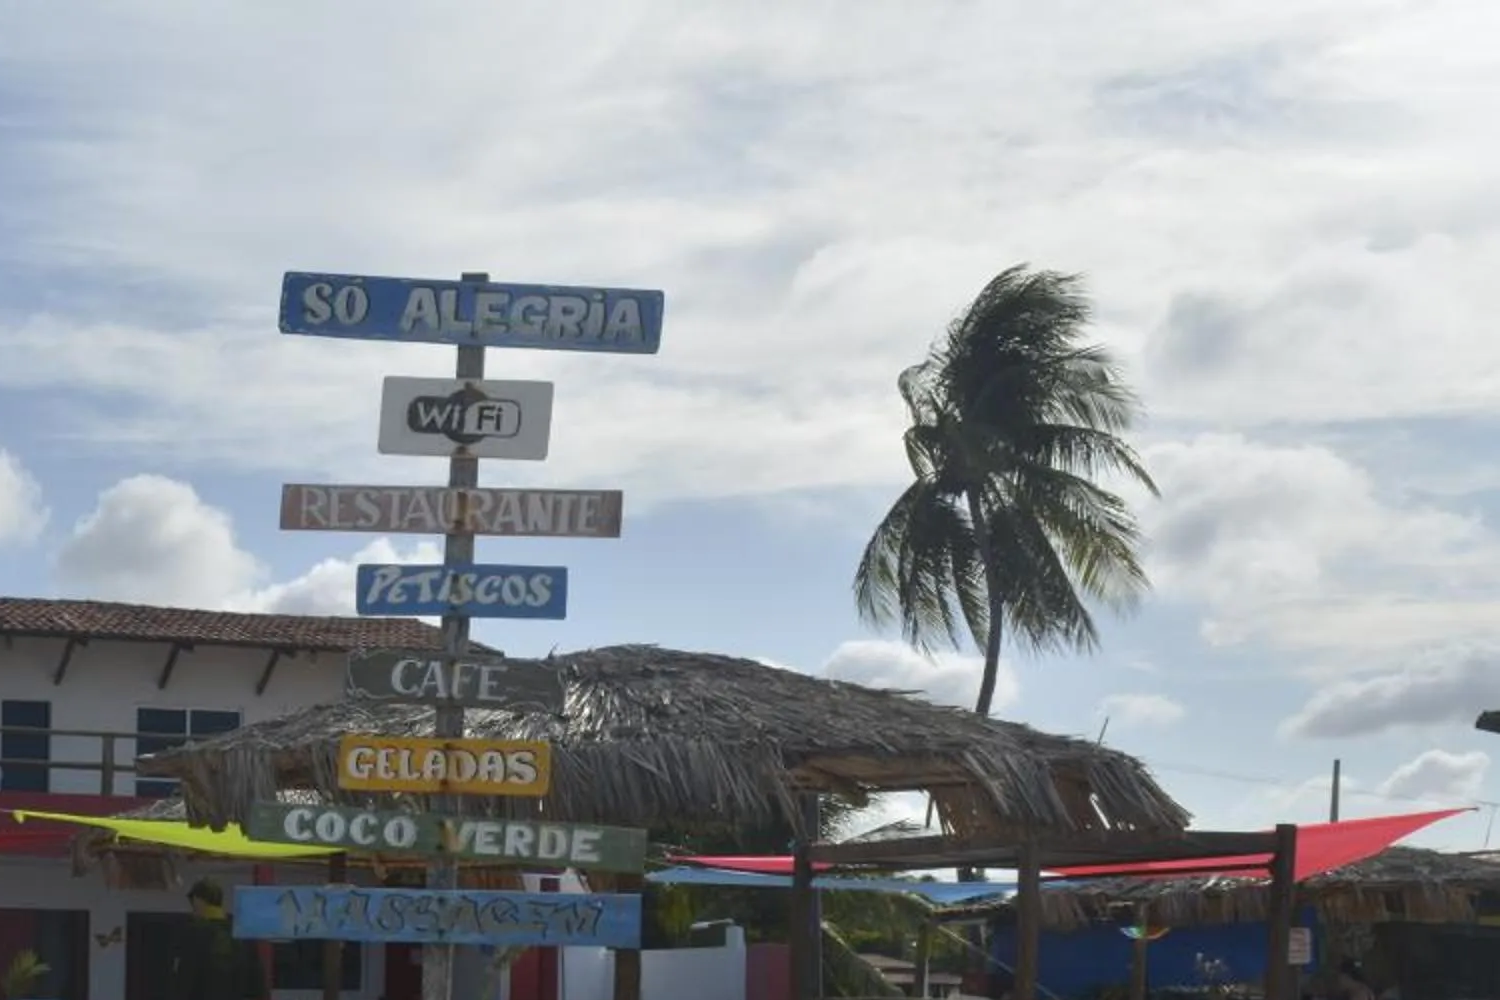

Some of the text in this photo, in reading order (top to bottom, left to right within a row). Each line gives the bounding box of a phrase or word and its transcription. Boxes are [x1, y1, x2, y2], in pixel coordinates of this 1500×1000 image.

[304, 279, 369, 326] SÓ
[300, 488, 599, 533] RESTAURANTE
[347, 746, 538, 785] GELADAS
[283, 807, 603, 862] COCO VERDE
